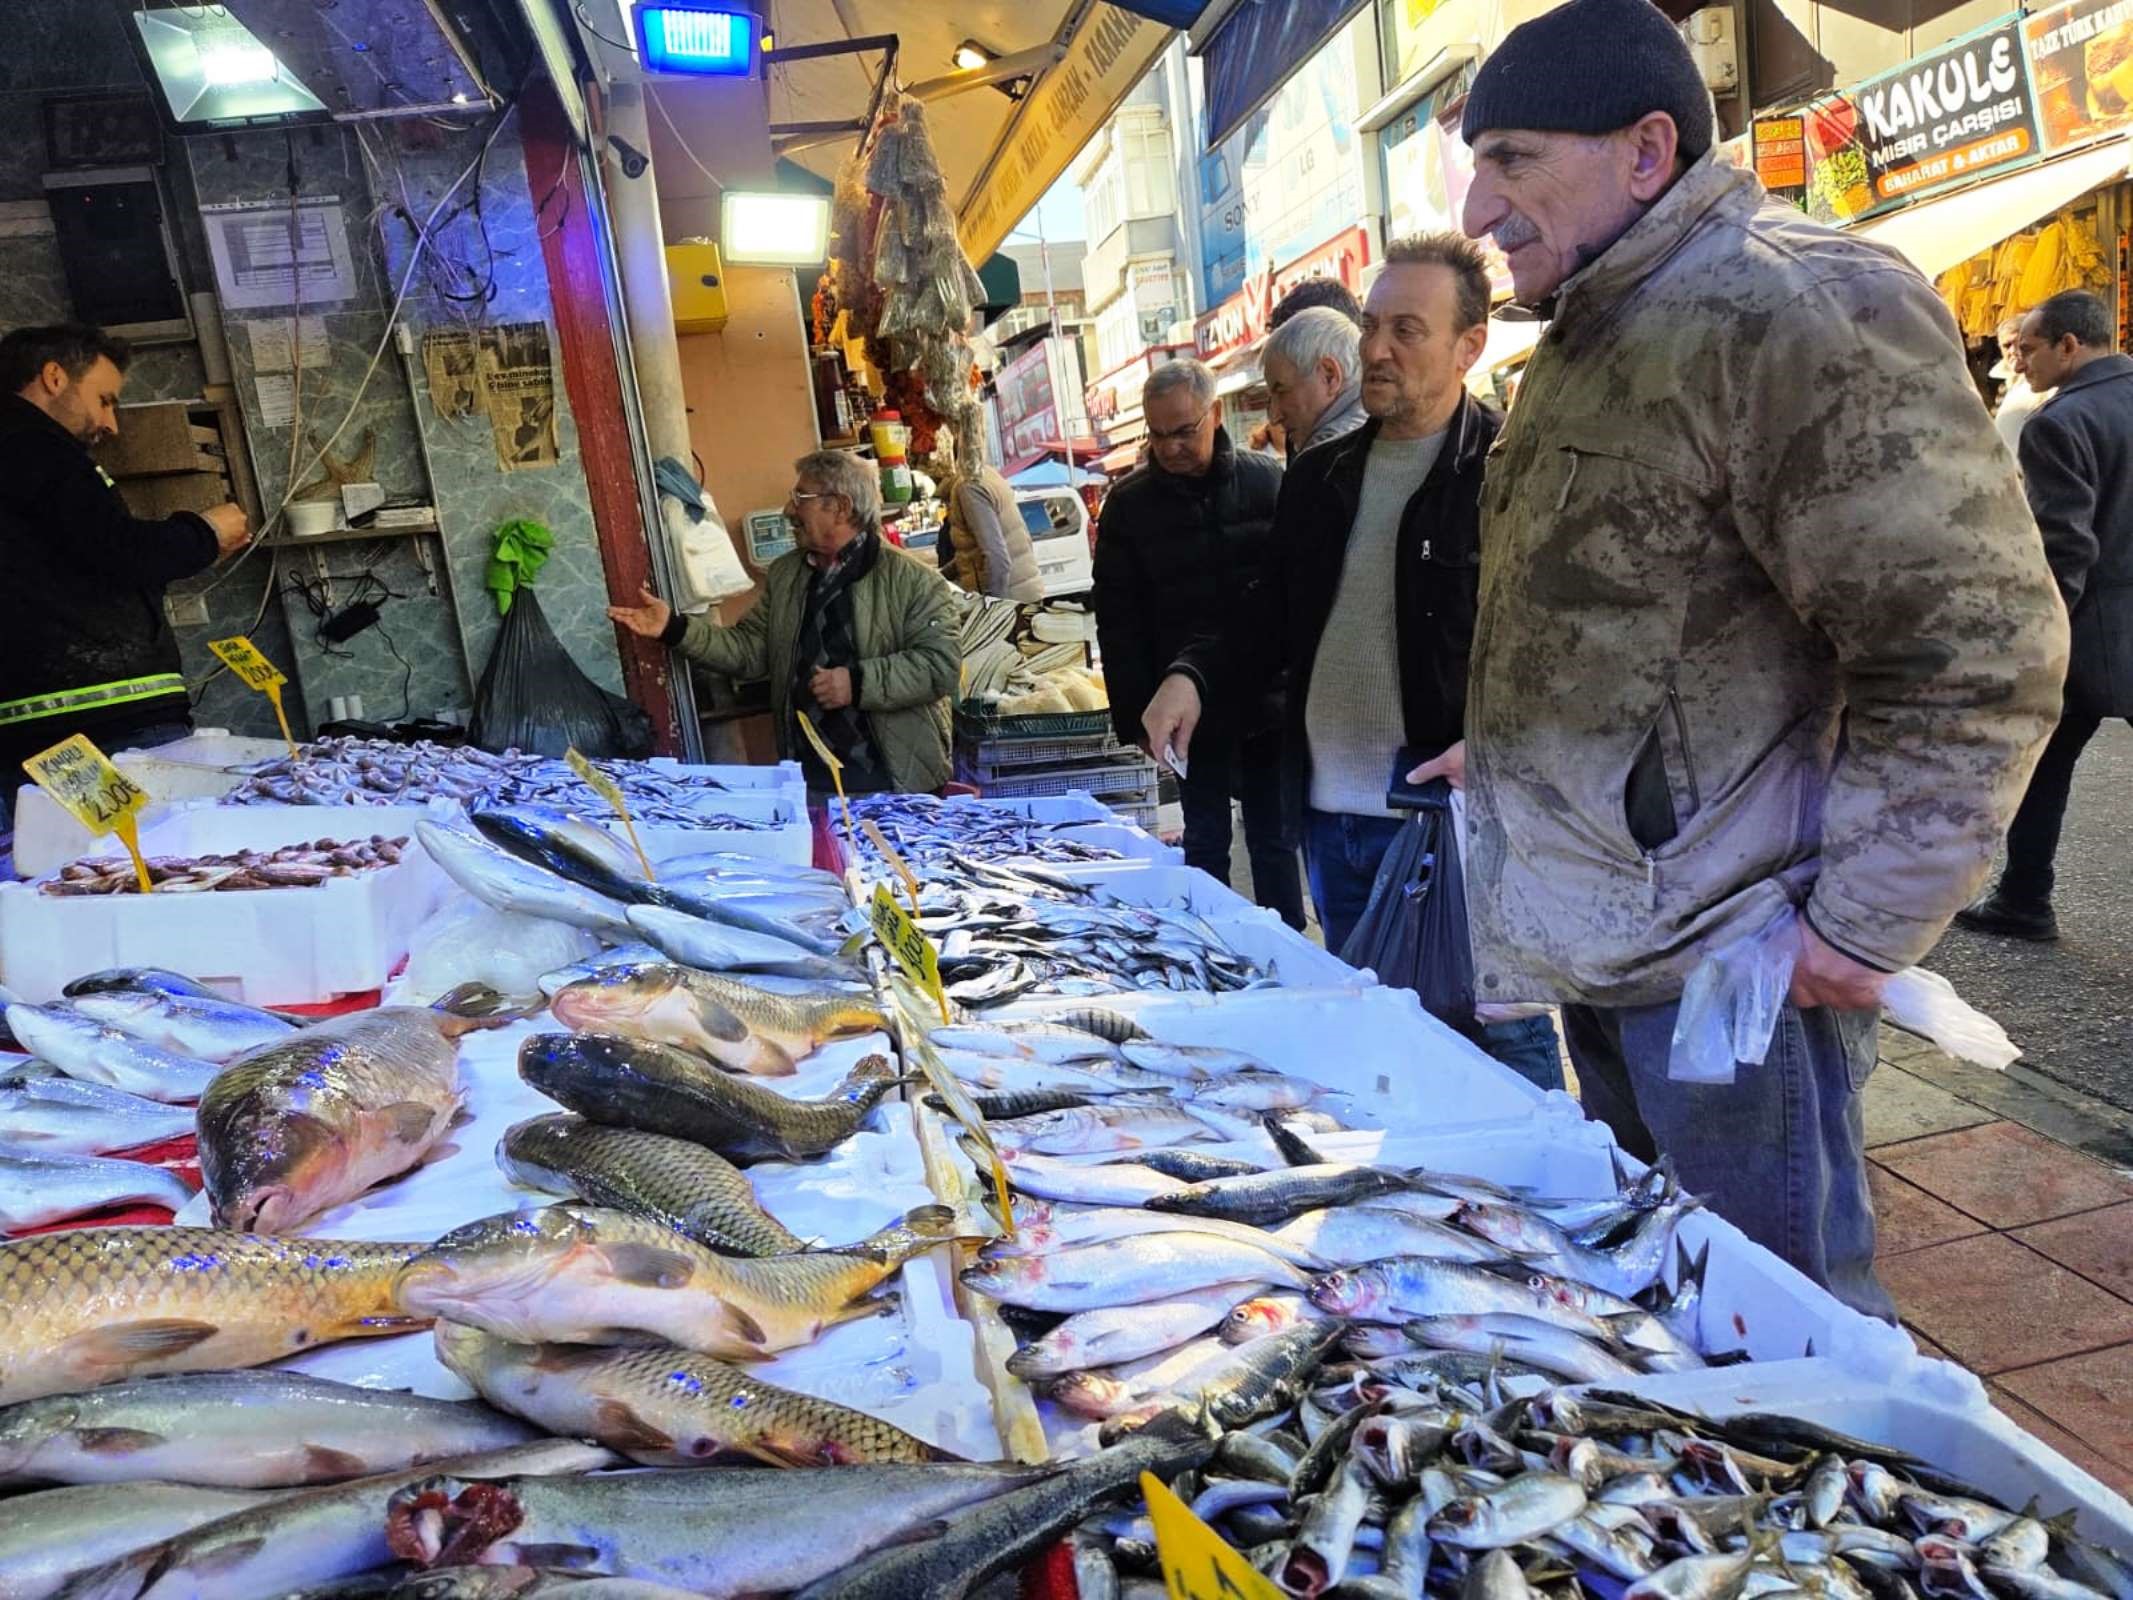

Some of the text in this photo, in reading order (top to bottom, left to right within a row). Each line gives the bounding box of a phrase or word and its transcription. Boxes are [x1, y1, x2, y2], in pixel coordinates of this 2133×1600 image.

[1863, 37, 2016, 143] KAKULE
[1872, 96, 2023, 168] MISIR ÇARŞISI
[1299, 148, 1315, 176] LG
[1884, 158, 1949, 193] BAHARAT
[1967, 134, 2020, 165] AKTAR
[1224, 191, 1261, 232] SONY
